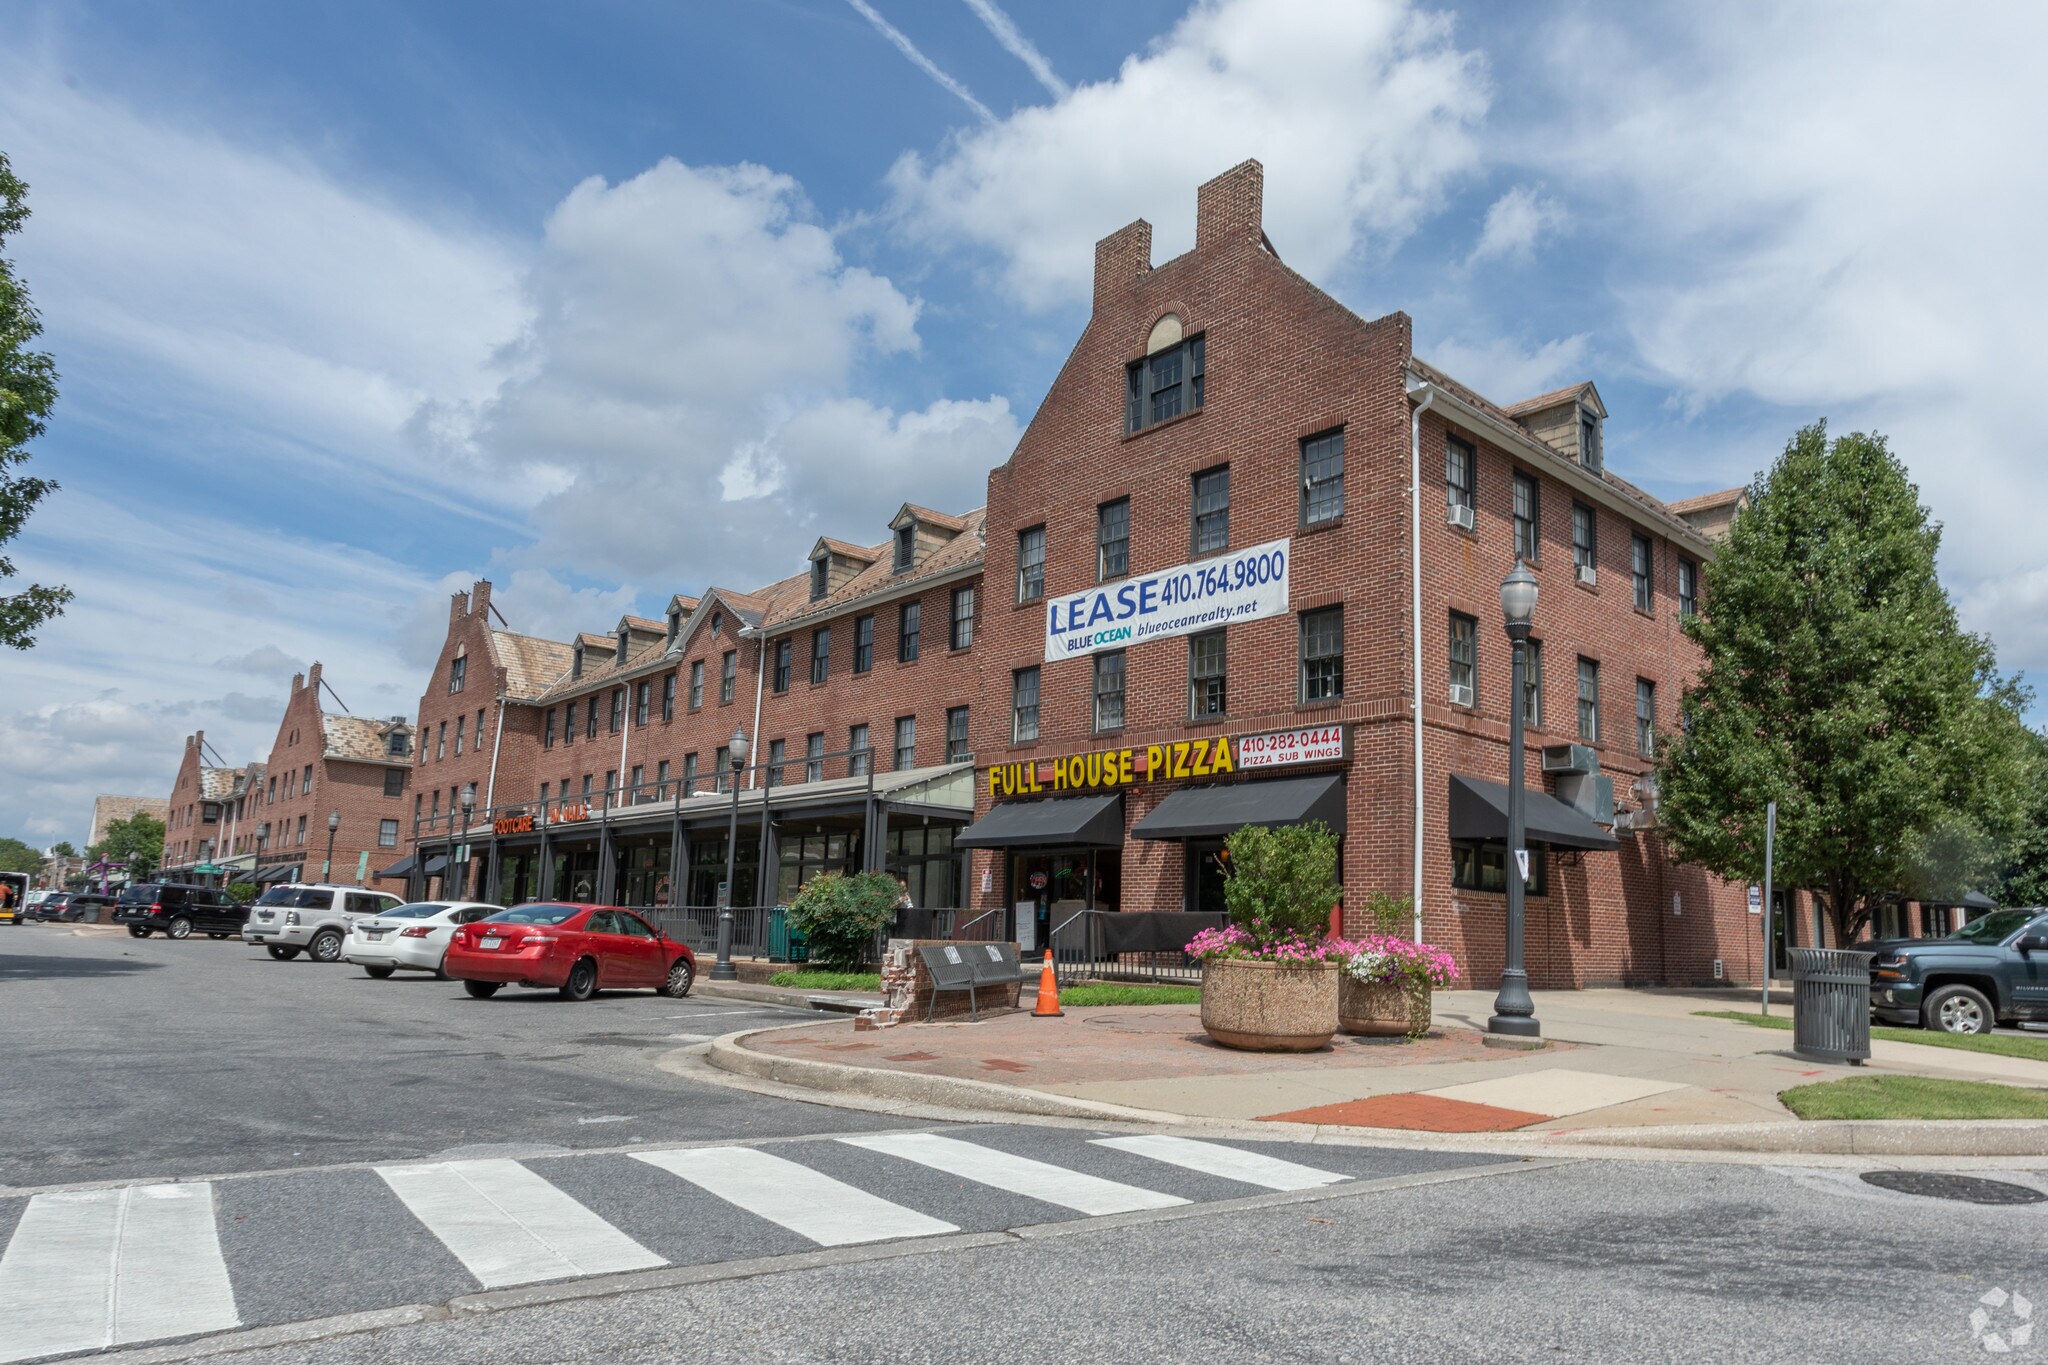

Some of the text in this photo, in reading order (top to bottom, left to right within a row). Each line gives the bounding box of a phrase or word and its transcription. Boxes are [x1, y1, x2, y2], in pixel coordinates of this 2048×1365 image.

[1050, 550, 1285, 636] LEASE 410.764.9800
[1137, 600, 1258, 637] blueoceanrealty.net
[1067, 626, 1132, 651] BLUE OCEAN
[1242, 727, 1341, 753] 410-282-0444
[989, 737, 1234, 796] FULL HOUSE PIZZA
[1243, 747, 1341, 766] PIZZA SUB WINGS
[493, 815, 533, 835] FOOTCARE
[563, 804, 588, 821] NAILS
